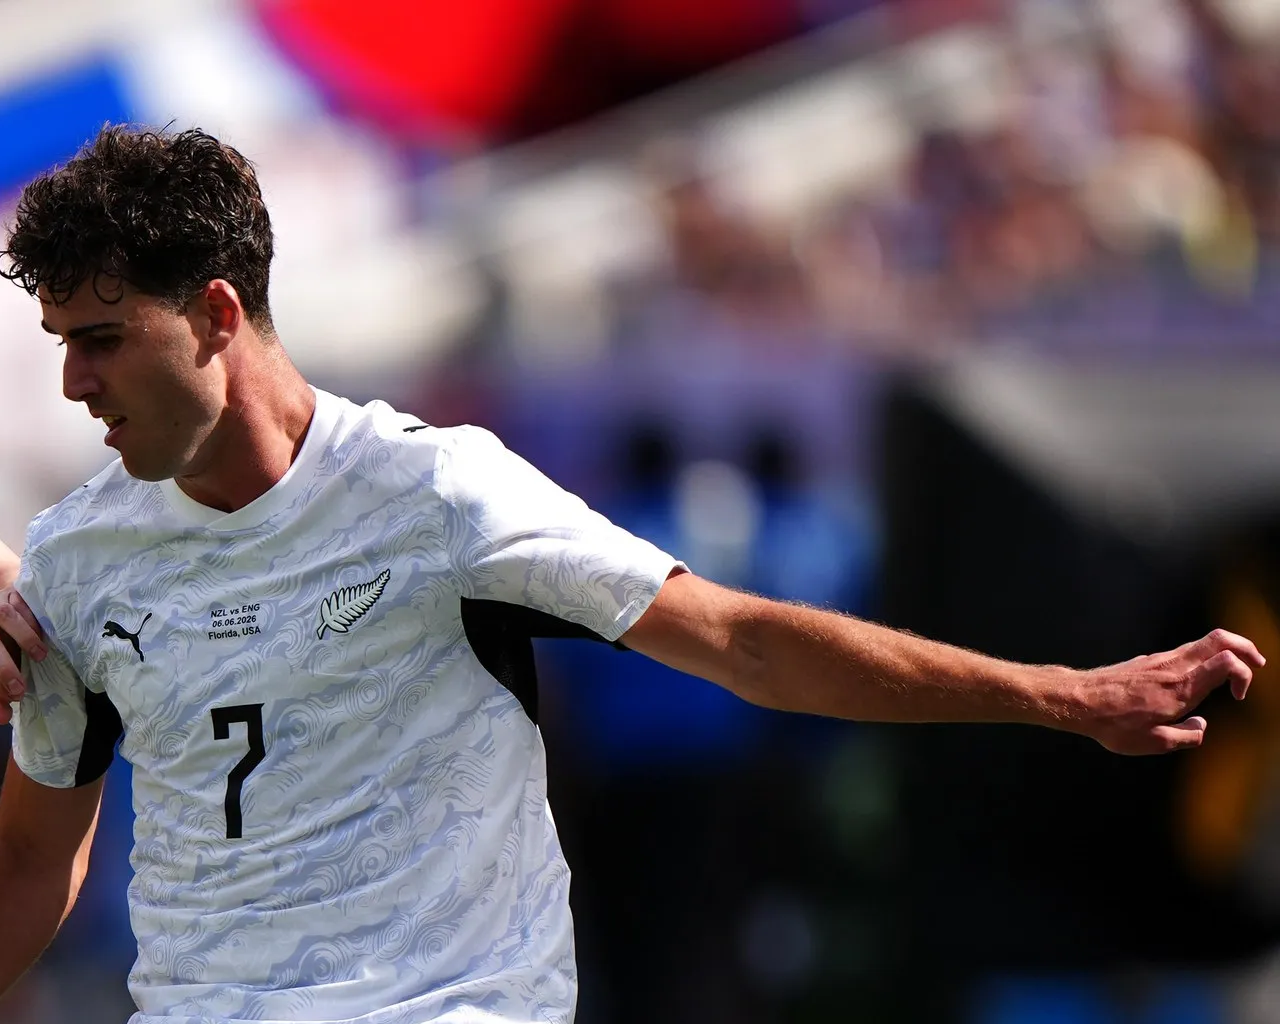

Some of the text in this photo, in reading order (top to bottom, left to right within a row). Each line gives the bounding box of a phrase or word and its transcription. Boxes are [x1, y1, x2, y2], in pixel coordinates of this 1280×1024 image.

[211, 609, 228, 618] NZL
[241, 603, 260, 613] ENG
[212, 615, 256, 627] 06.06.2026
[208, 626, 261, 640] Florida, USA
[211, 703, 266, 839] 7
